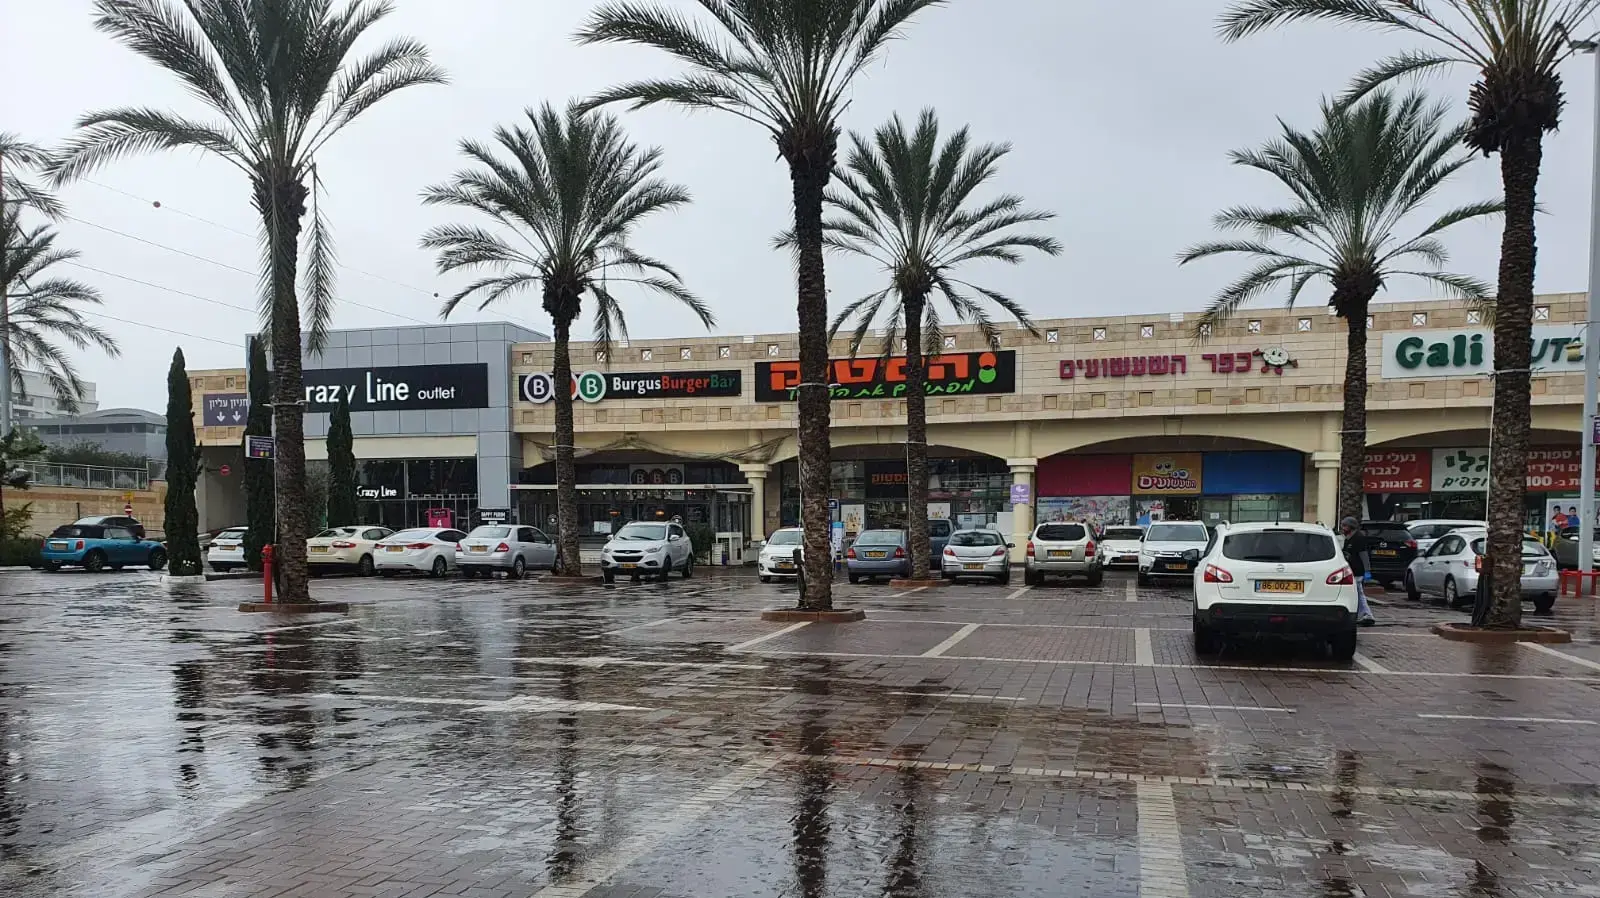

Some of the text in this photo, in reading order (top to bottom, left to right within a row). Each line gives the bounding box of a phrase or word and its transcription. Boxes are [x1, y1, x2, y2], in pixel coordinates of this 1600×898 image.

[1395, 334, 1484, 369] Gali
[1059, 352, 1252, 379] כפר השעשועים
[304, 371, 456, 405] razy Line outlet
[854, 384, 885, 398] את
[209, 398, 228, 411] עליון
[1412, 478, 1423, 488] 2
[381, 485, 397, 497] Line
